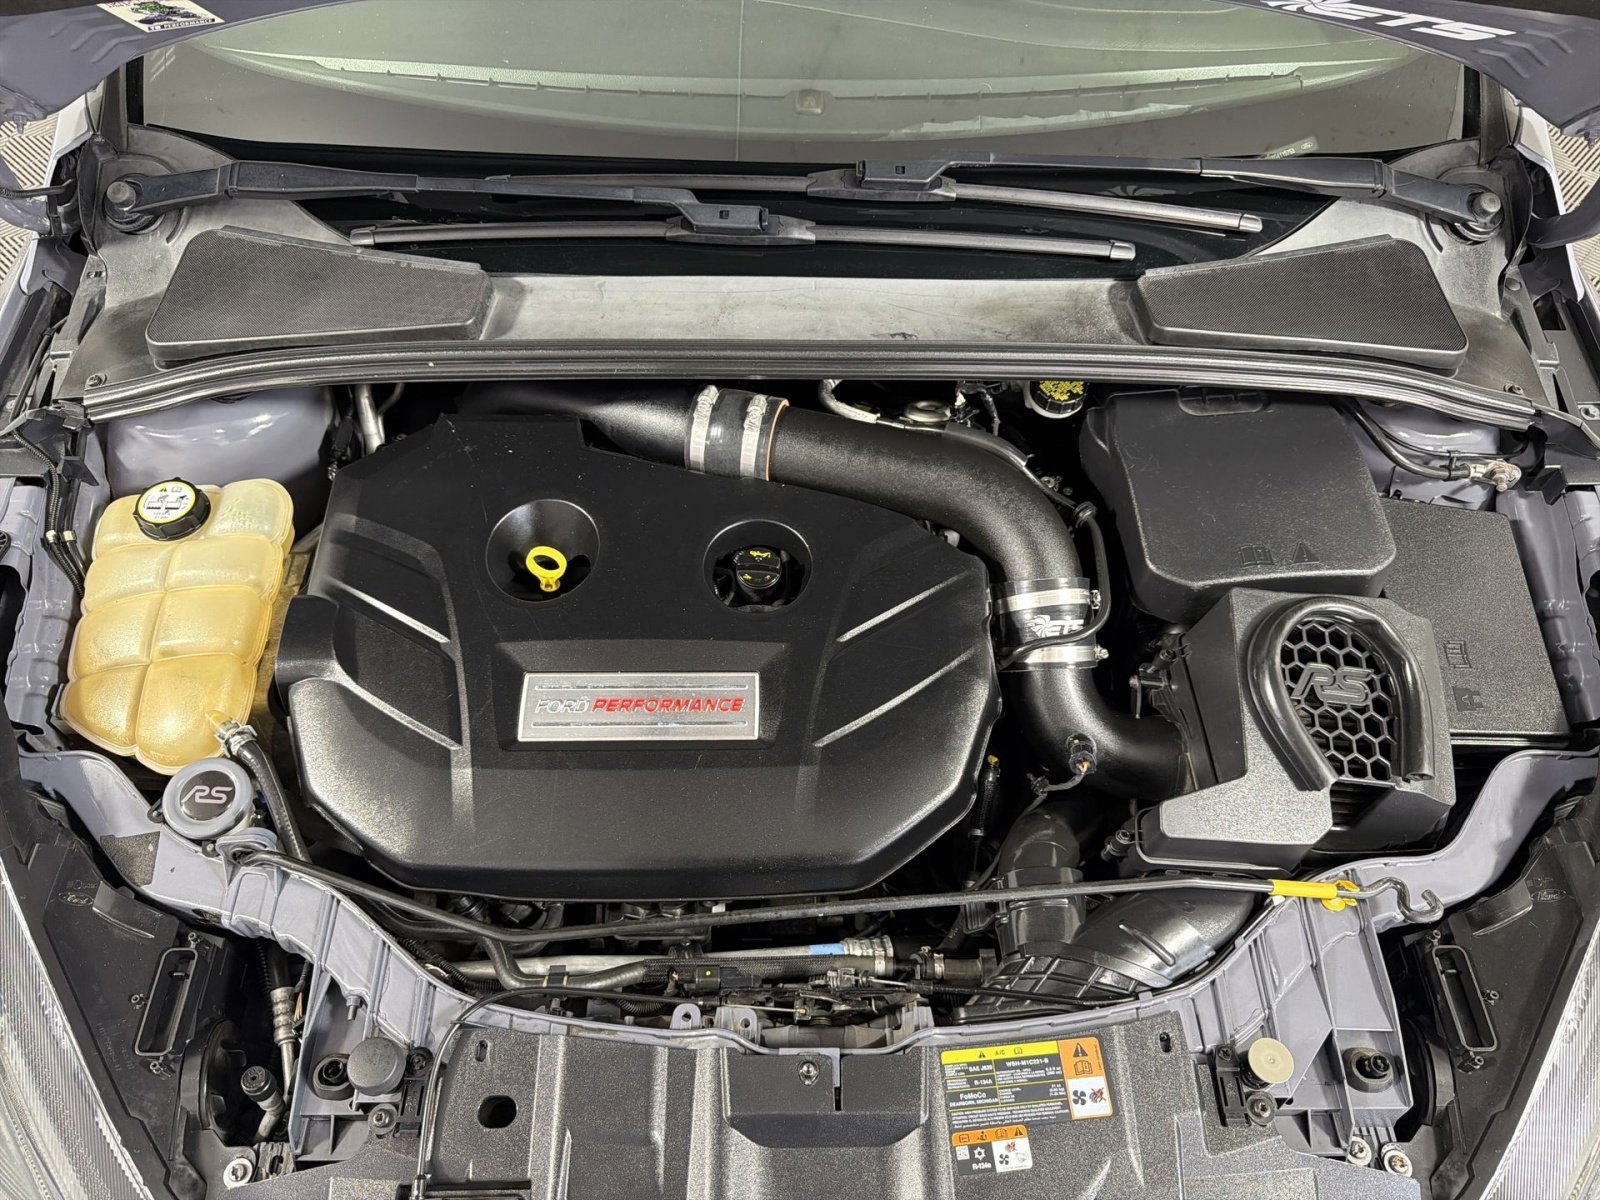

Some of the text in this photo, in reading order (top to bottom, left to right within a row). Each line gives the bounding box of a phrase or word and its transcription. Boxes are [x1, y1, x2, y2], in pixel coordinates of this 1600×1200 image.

[163, 18, 210, 30] PERFORMANCE
[1290, 661, 1374, 706] RS
[534, 696, 746, 714] FORD PERFORMANCE
[181, 785, 234, 805] RS
[973, 1078, 993, 1086] R-134A
[959, 1091, 987, 1100] FoMoCo
